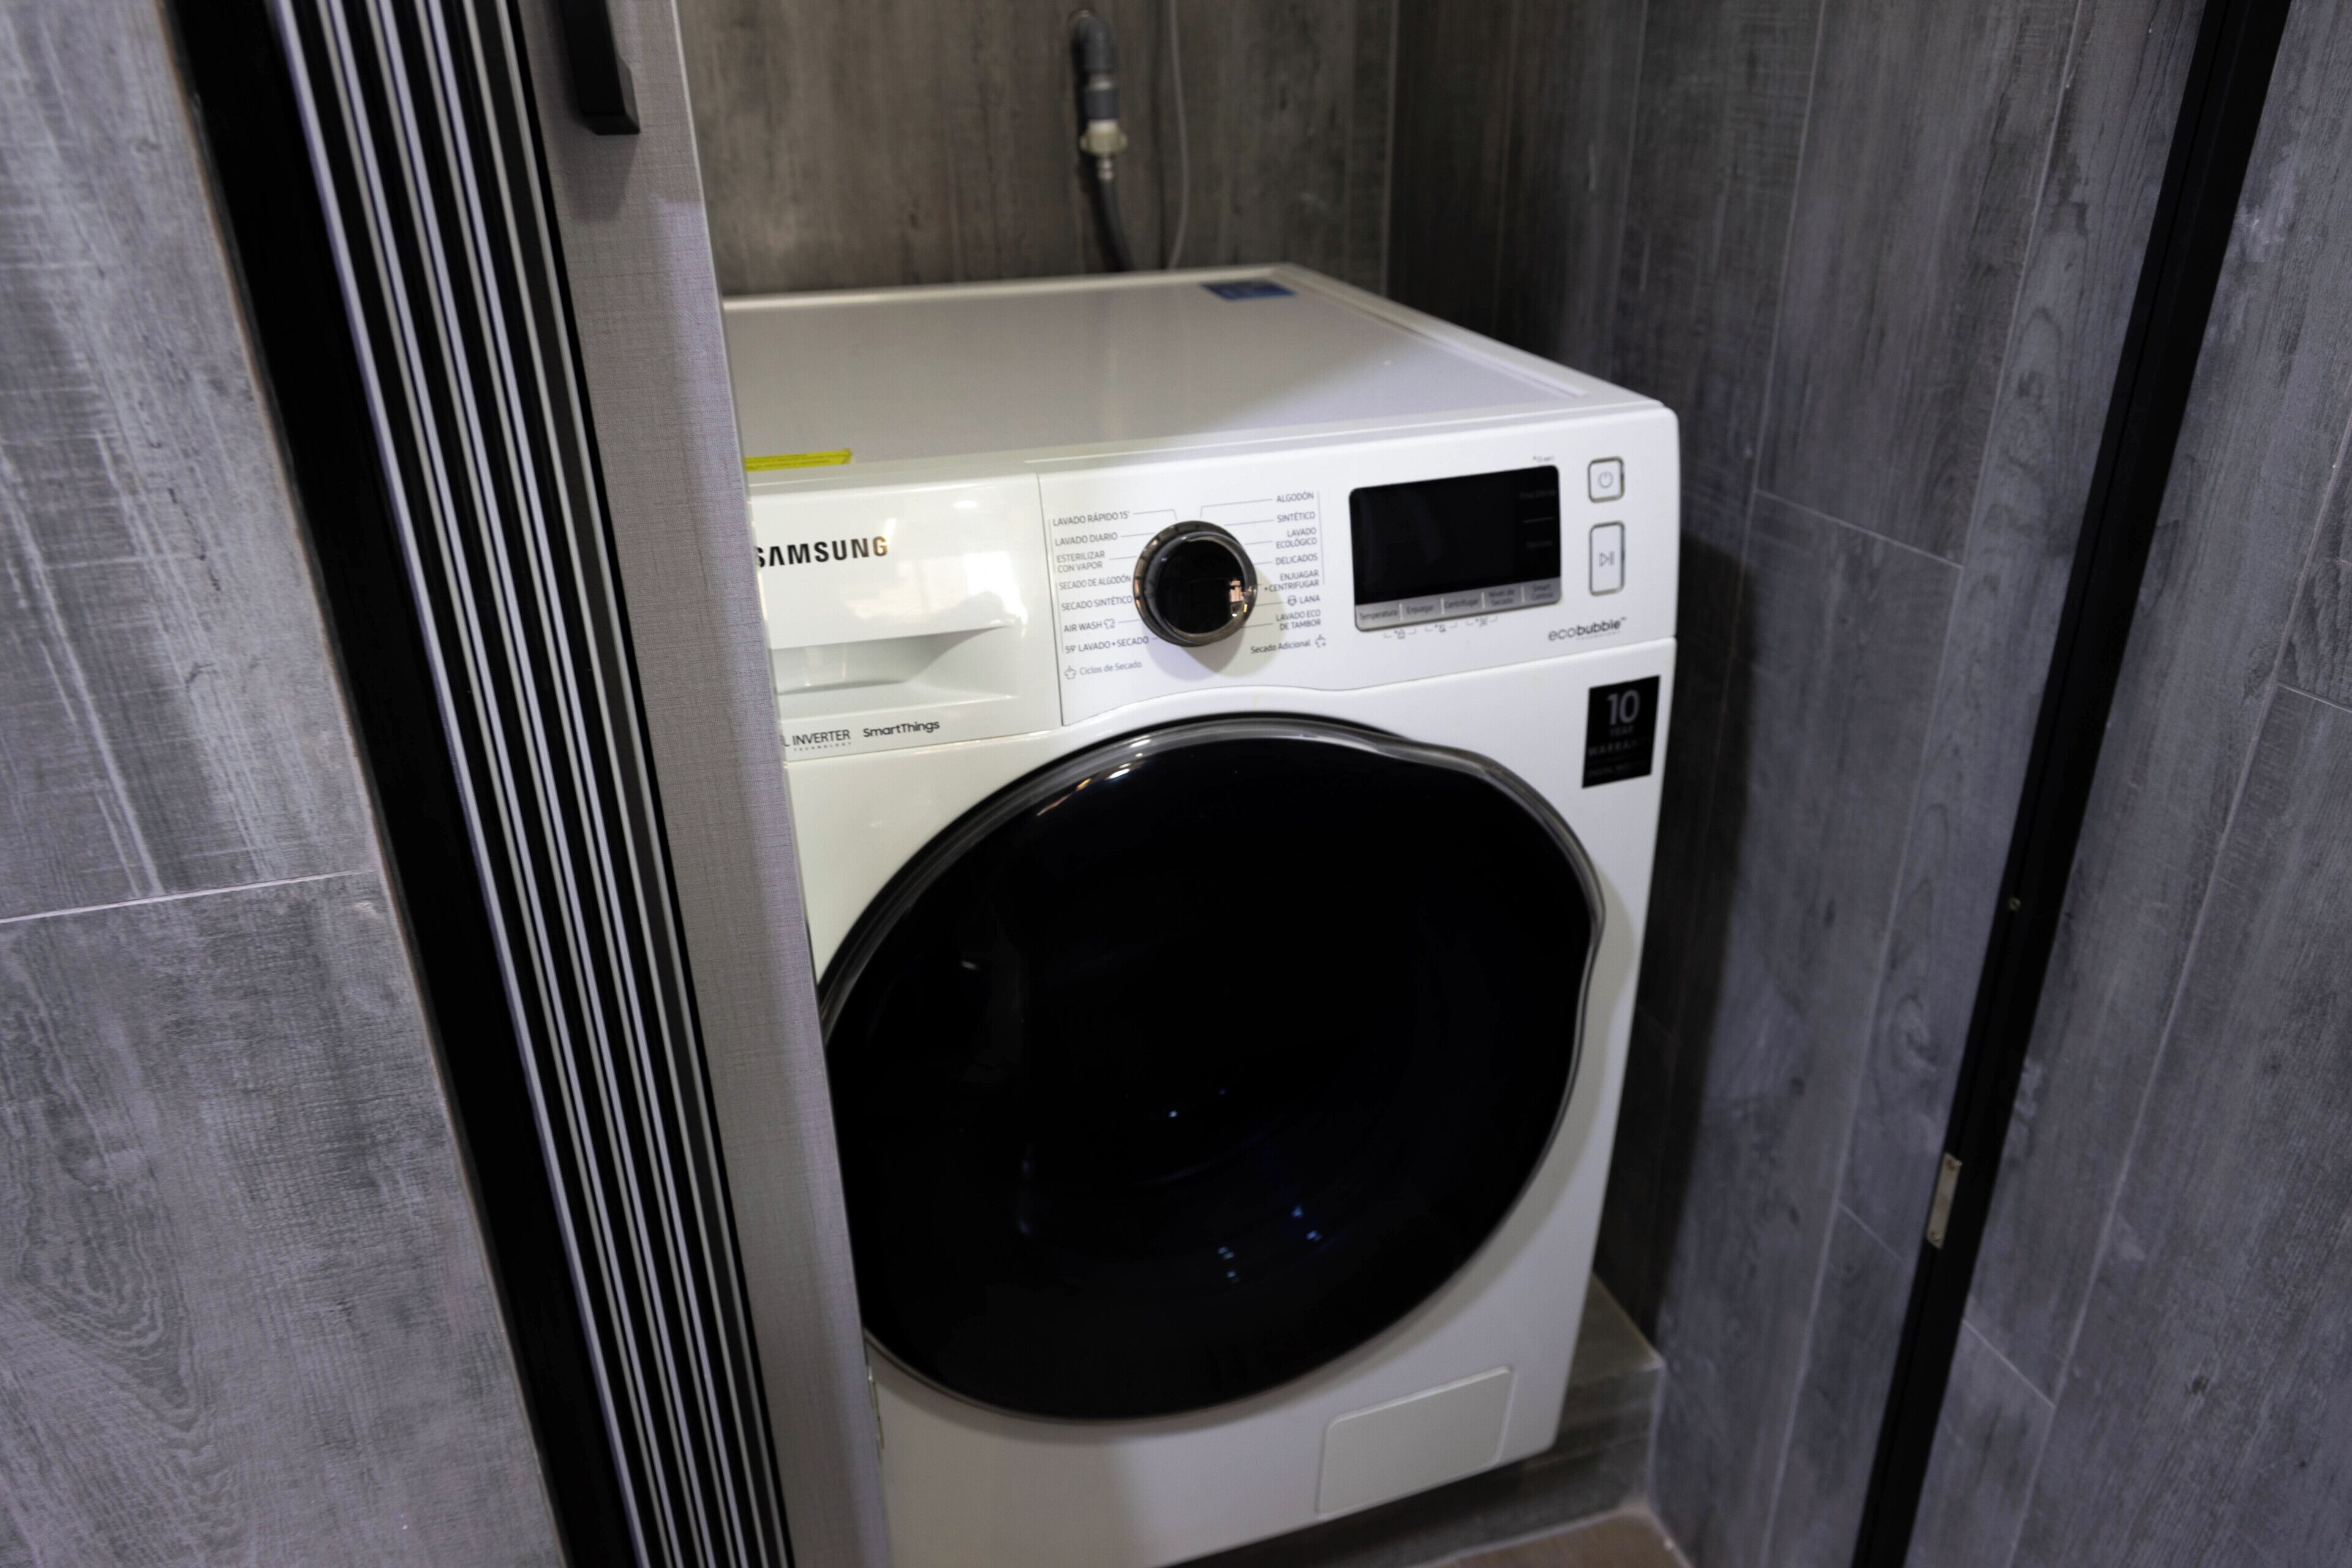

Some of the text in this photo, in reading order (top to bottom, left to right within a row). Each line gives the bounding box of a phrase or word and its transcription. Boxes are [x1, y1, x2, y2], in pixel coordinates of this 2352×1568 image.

[1277, 491, 1314, 502] ALGODÓN
[1053, 516, 1086, 526] LAVADO
[1087, 512, 1118, 522] RÁPIDO
[1277, 511, 1315, 522] SINTÉTICO
[1287, 527, 1316, 537] LAVADO
[1055, 532, 1117, 546] LAVADO DIARIO
[1276, 537, 1317, 549] ECOLÓGICO
[1057, 551, 1105, 562] ESTERILIZAR
[1276, 553, 1318, 565] DELICADOS
[1076, 561, 1102, 570] VAPOR
[1280, 570, 1319, 581] ENJUAGAR
[1059, 575, 1131, 590] SECADO DE ALGODÓN
[1061, 595, 1132, 611] SECADO SINTÉTICO
[1300, 595, 1320, 603] LANA
[1276, 609, 1321, 621] LAVADO ECO
[1079, 621, 1102, 630] WASH
[1291, 619, 1321, 628] TAMBOR
[1548, 619, 1621, 641] ecobubble
[1251, 643, 1276, 654] Secado
[1079, 666, 1102, 675] Ciclos
[1115, 661, 1142, 671] Secado
[1607, 690, 1640, 726] 10
[792, 729, 851, 745] INVERTER
[863, 721, 940, 737] SmartThings
